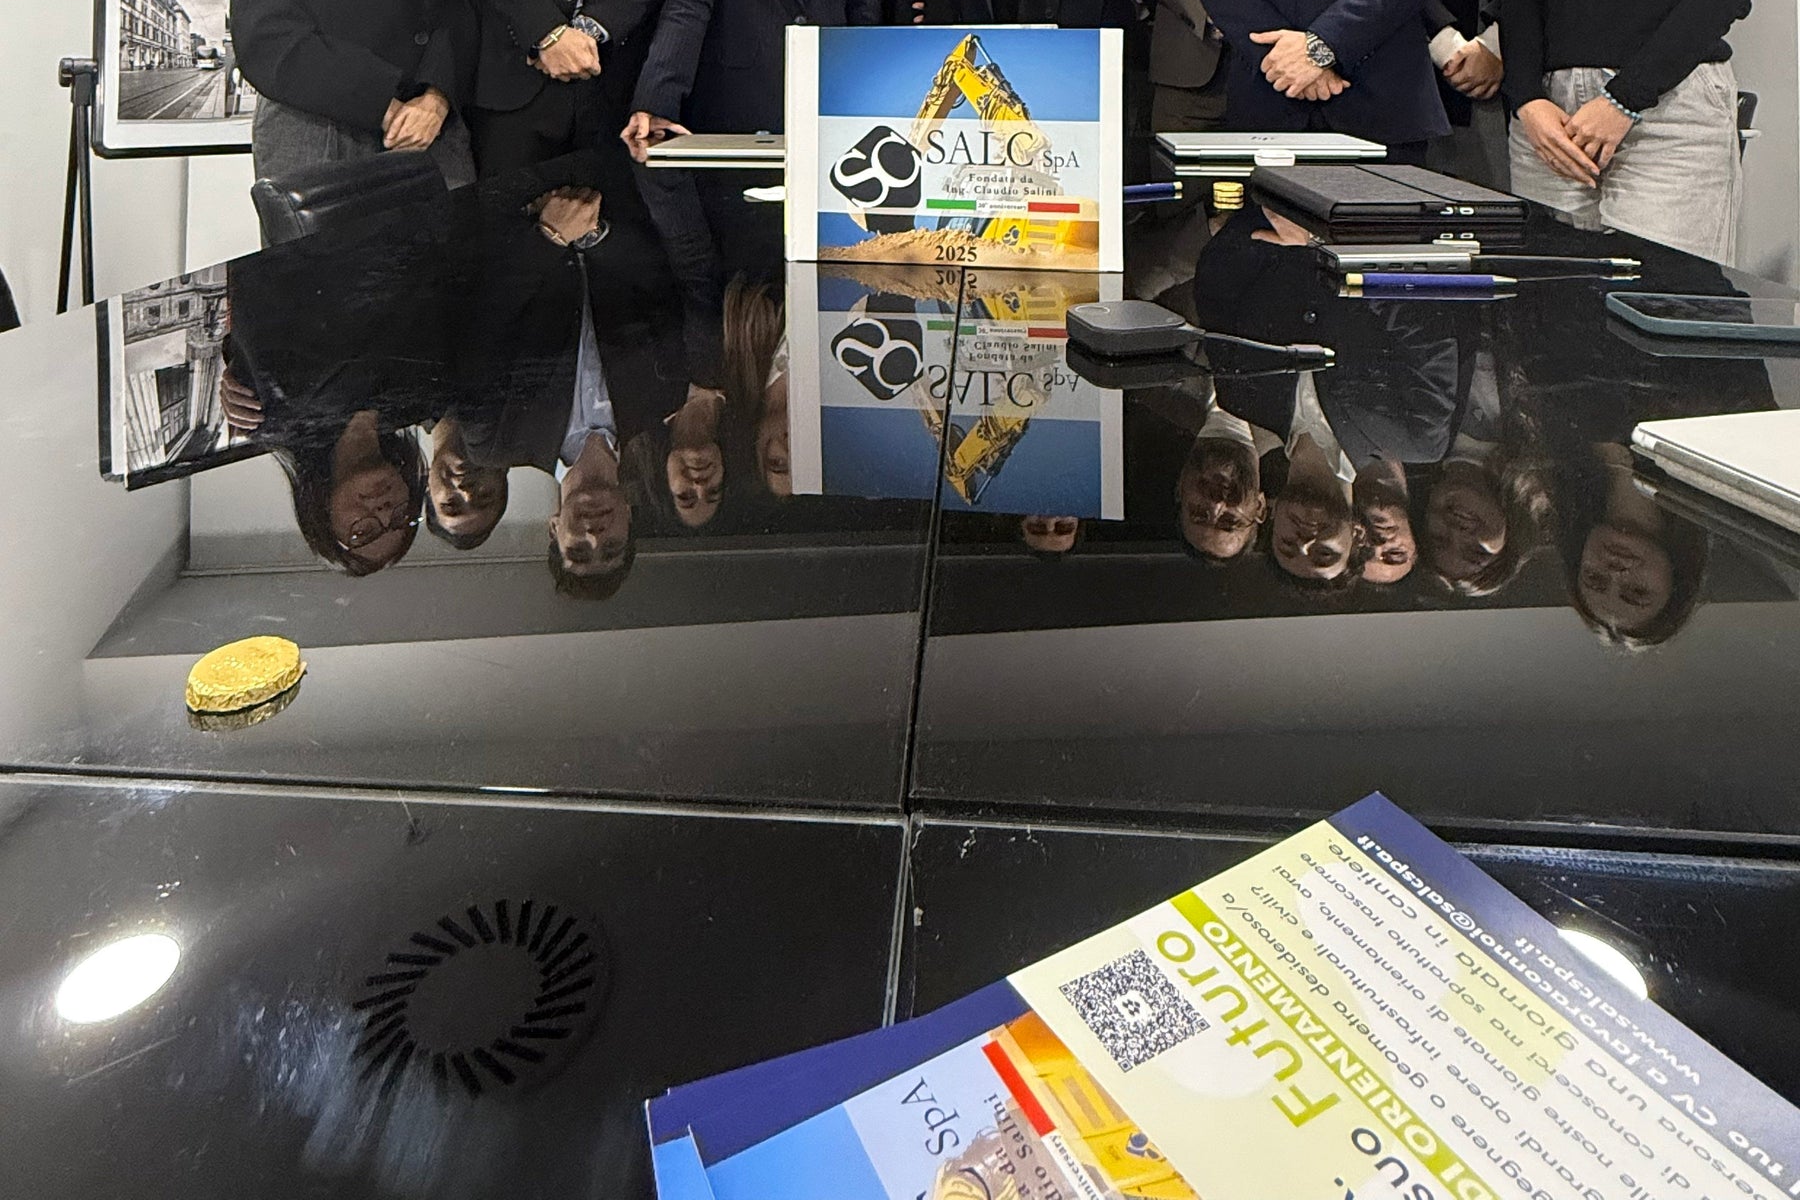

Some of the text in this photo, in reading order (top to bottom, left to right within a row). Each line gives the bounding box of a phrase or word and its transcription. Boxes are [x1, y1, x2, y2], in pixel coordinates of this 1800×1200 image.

[927, 130, 1080, 173] SALC SpA
[969, 173, 1034, 184] Fondata da
[946, 185, 1057, 196] Ing. Claudio Salini
[935, 245, 977, 262] 2025
[1250, 885, 1298, 926] civili?
[1272, 865, 1312, 899] avrai
[1328, 839, 1417, 920] cantiere.
[1222, 893, 1330, 997] desideroso/a
[1301, 929, 1313, 940] e
[1319, 901, 1425, 1001] orientamento,
[1357, 834, 1642, 1065] lavoraconnoi@salcspa.it
[1425, 924, 1449, 948] in
[1157, 931, 1342, 1128] Futuro
[1300, 852, 1690, 1189] di conoscerci ma soprattutto trascorrere
[1313, 944, 1441, 1061] infrastrutturali
[1426, 1004, 1450, 1023] di
[1456, 951, 1579, 1051] giornata
[1514, 936, 1700, 1085] www.salcspa.it
[1203, 921, 1437, 1155] ORIENTAMENTO
[1333, 1001, 1429, 1089] geometra
[1453, 1026, 1542, 1101] giornate
[1430, 1094, 1445, 1108] o
[1447, 1064, 1511, 1124] opere
[1585, 1059, 1647, 1111] una
[1646, 1067, 1669, 1085] a
[900, 1076, 960, 1156] SpA
[984, 1093, 1032, 1159] Salini
[1544, 1106, 1613, 1168] nostre
[1670, 1094, 1718, 1126] CV
[995, 1147, 1016, 1176] da
[1728, 1130, 1783, 1177] tuo
